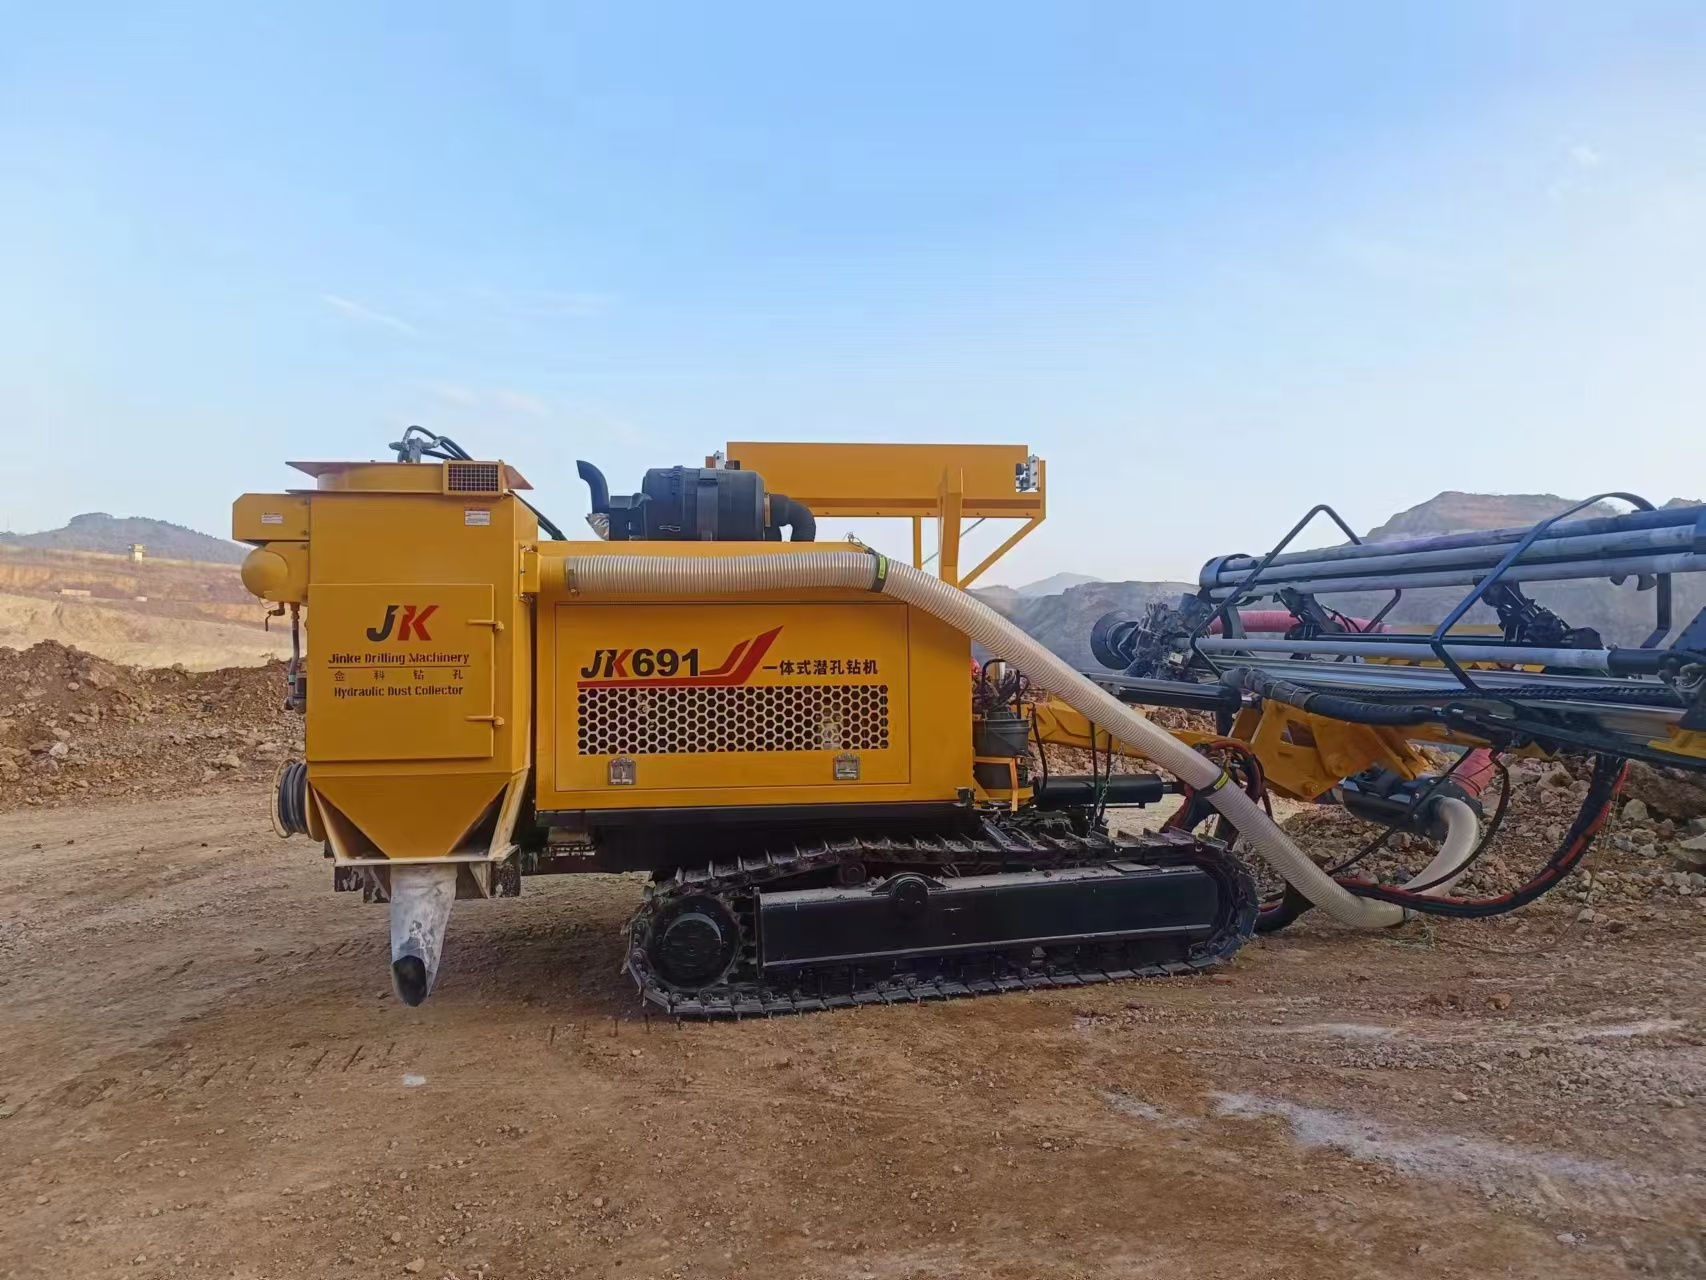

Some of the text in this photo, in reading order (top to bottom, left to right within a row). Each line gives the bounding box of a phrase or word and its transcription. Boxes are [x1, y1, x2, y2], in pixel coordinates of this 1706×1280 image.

[366, 605, 439, 642] JK
[328, 652, 470, 665] Jinke Drilling Machinery
[580, 648, 699, 678] JK691
[762, 659, 878, 675] 一体式潜孔钻机
[334, 685, 463, 699] Hydraulic Dust Collector
